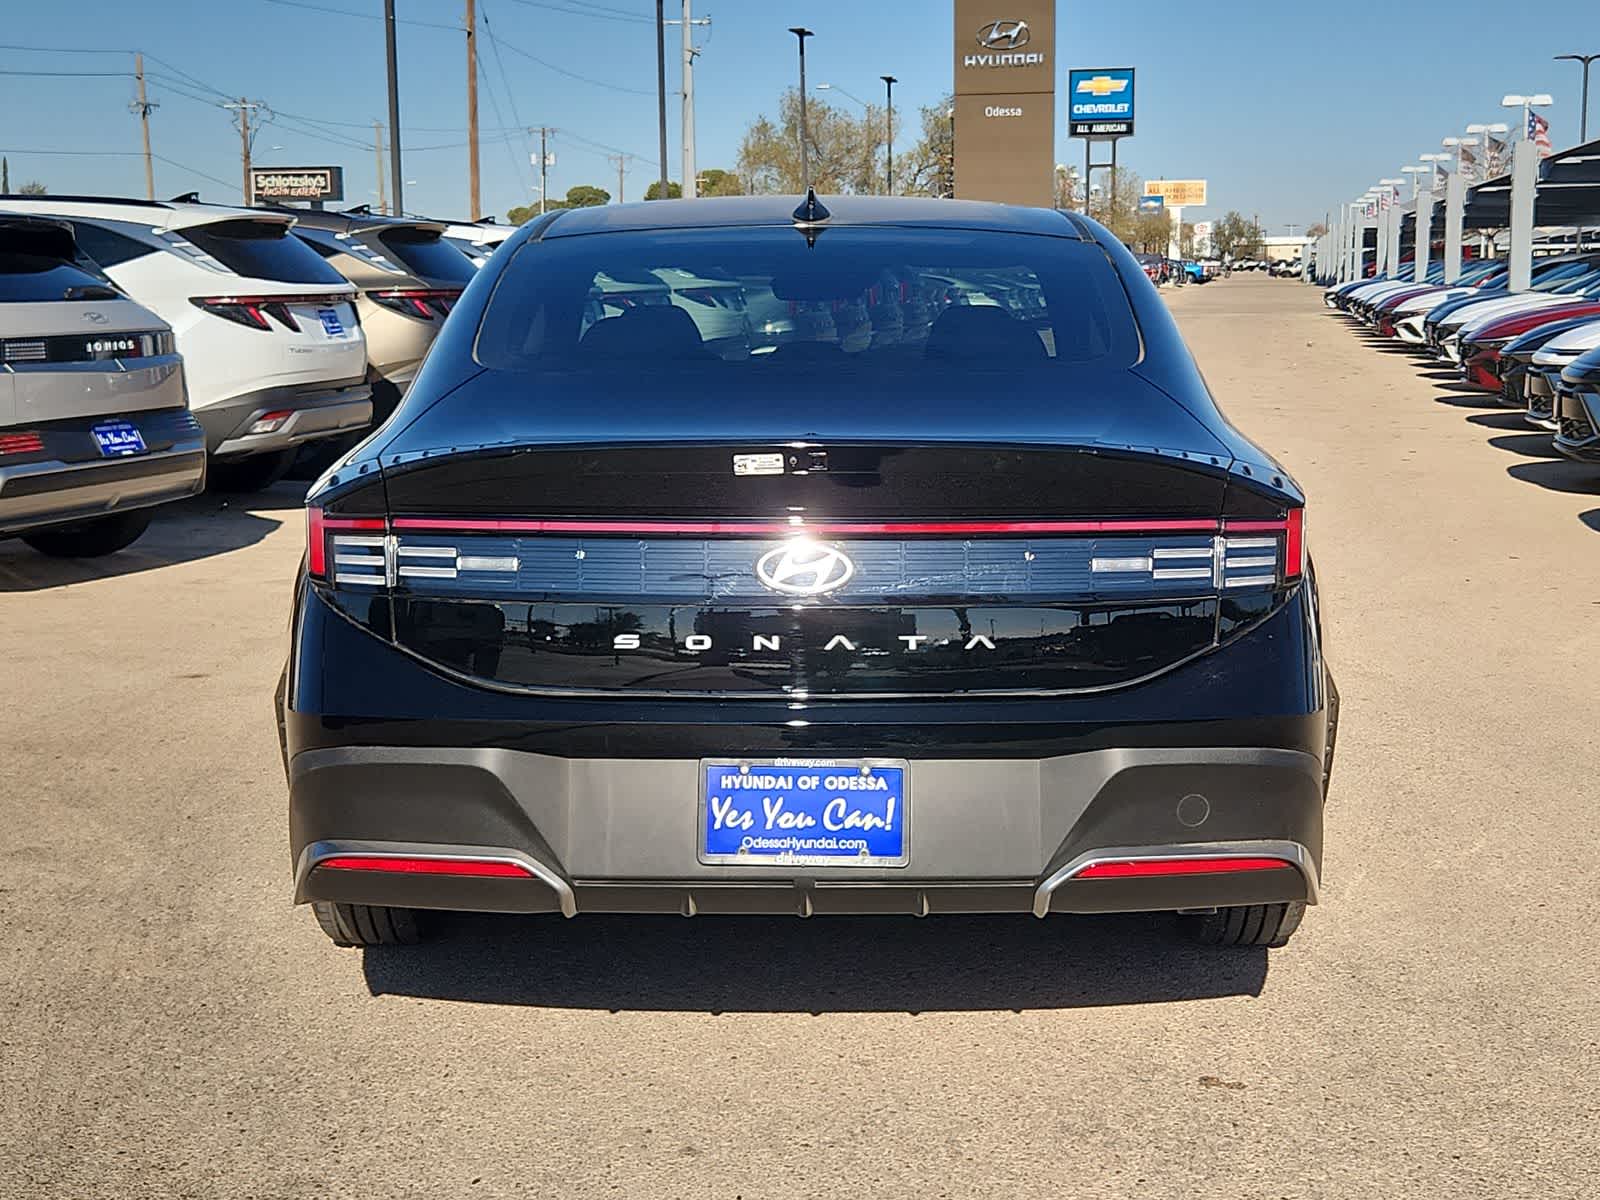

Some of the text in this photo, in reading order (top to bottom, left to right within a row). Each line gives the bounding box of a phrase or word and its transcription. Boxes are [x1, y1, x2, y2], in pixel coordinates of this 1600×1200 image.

[964, 53, 1044, 67] HYUNDAI
[985, 106, 1023, 117] Odessa
[1073, 103, 1130, 114] CHEVROLET
[1076, 124, 1127, 133] ALL AMERICAN
[257, 174, 326, 188] Schlotzsky's
[613, 634, 996, 651] SONATA
[774, 758, 836, 769] driveway.com
[721, 775, 888, 791] HYUNDAI OF ODESSA
[711, 796, 896, 831] Yes You Can!
[742, 836, 867, 850] OdessaHyundai.com
